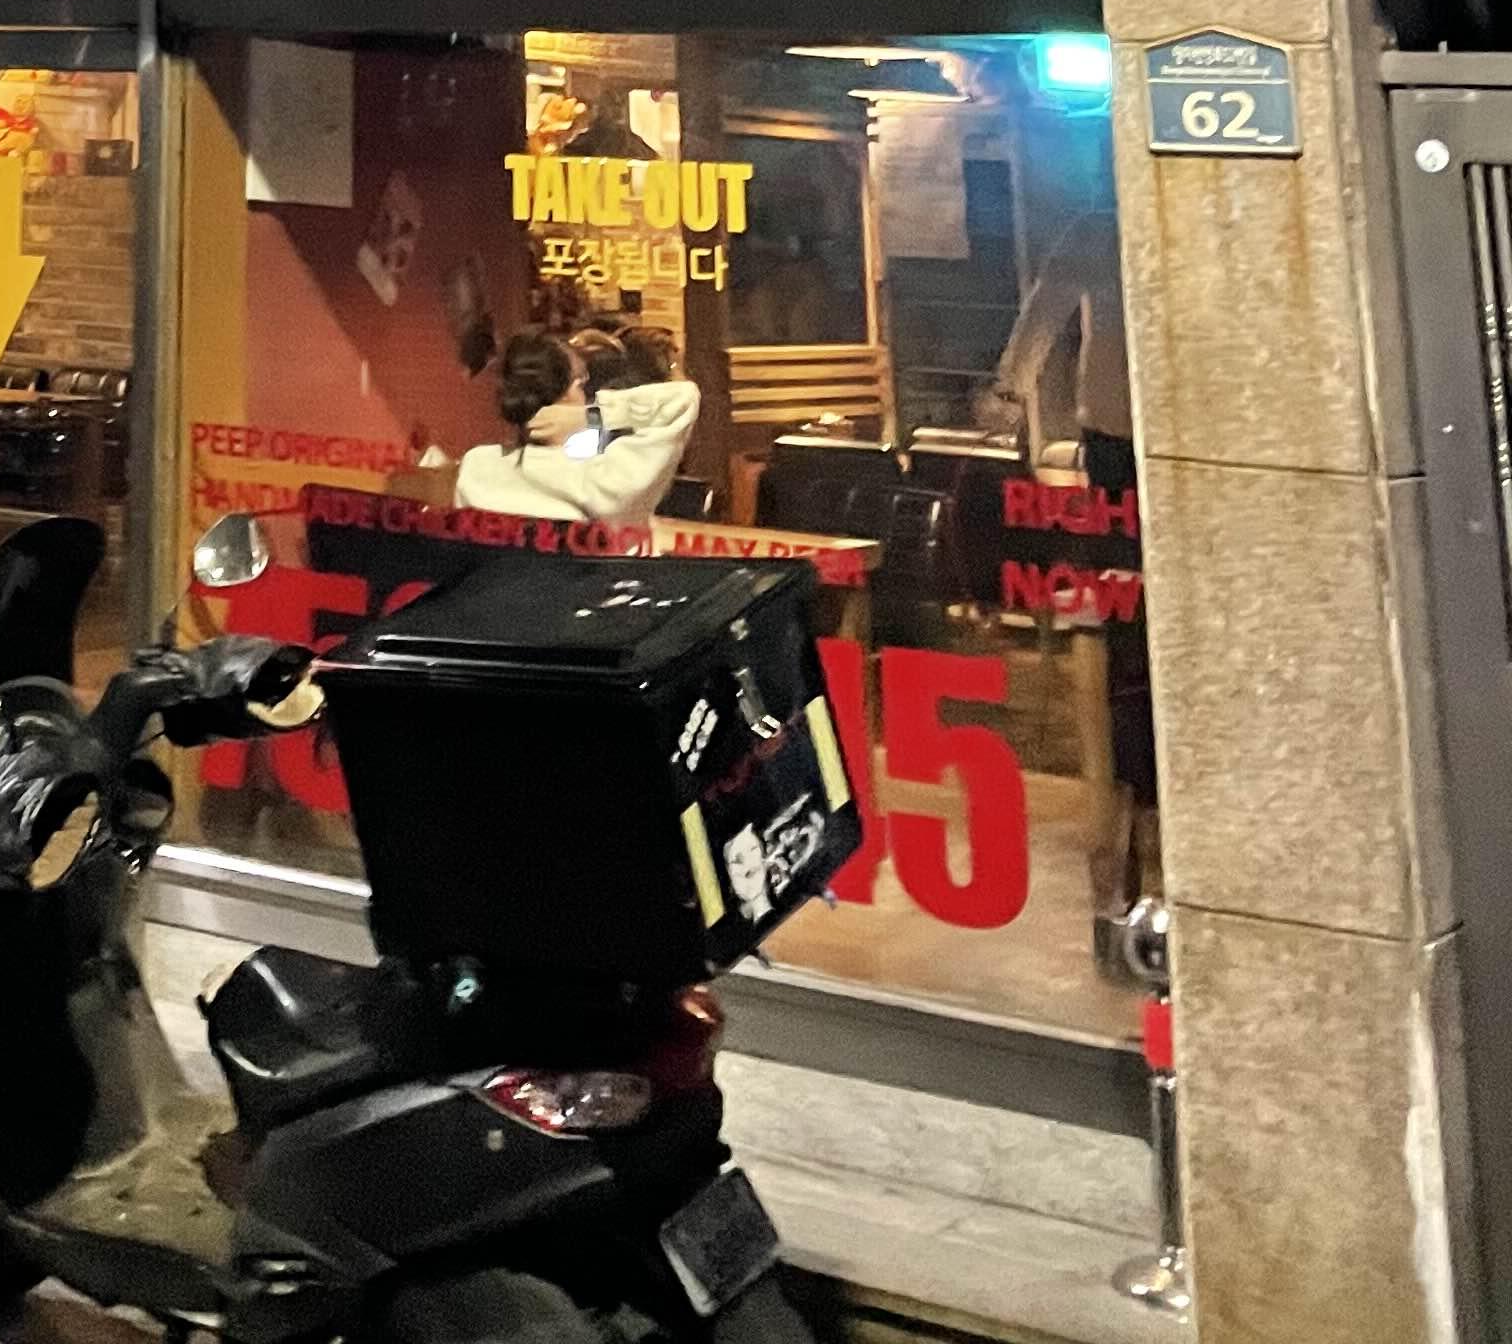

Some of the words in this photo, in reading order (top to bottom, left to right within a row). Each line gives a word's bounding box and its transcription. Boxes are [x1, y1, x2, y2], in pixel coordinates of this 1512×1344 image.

[1181, 89, 1261, 139] 62
[504, 153, 634, 227] TAKE
[642, 161, 754, 234] OUT
